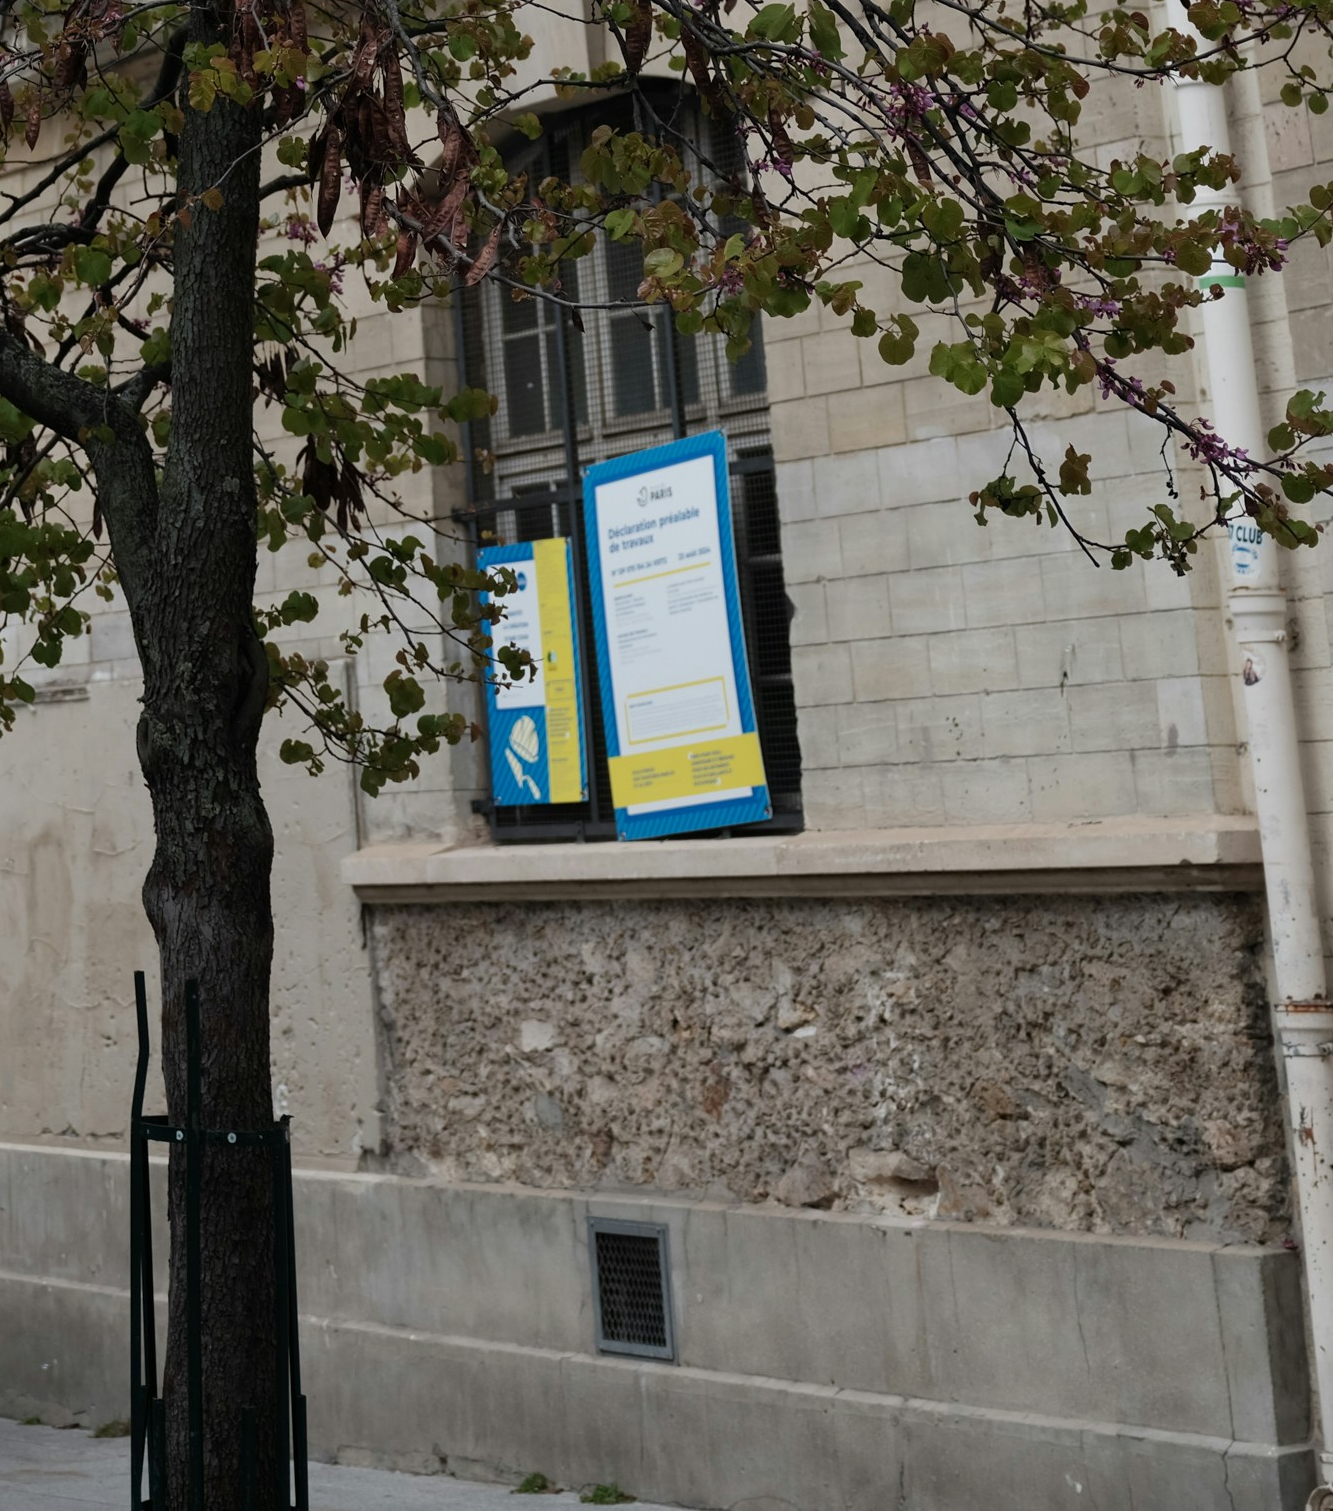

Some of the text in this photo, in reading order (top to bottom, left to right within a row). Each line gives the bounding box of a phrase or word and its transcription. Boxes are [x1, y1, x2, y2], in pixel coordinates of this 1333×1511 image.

[650, 486, 673, 502] PARIS
[608, 506, 700, 540] Déclaration préalable
[609, 534, 655, 554] de travaux
